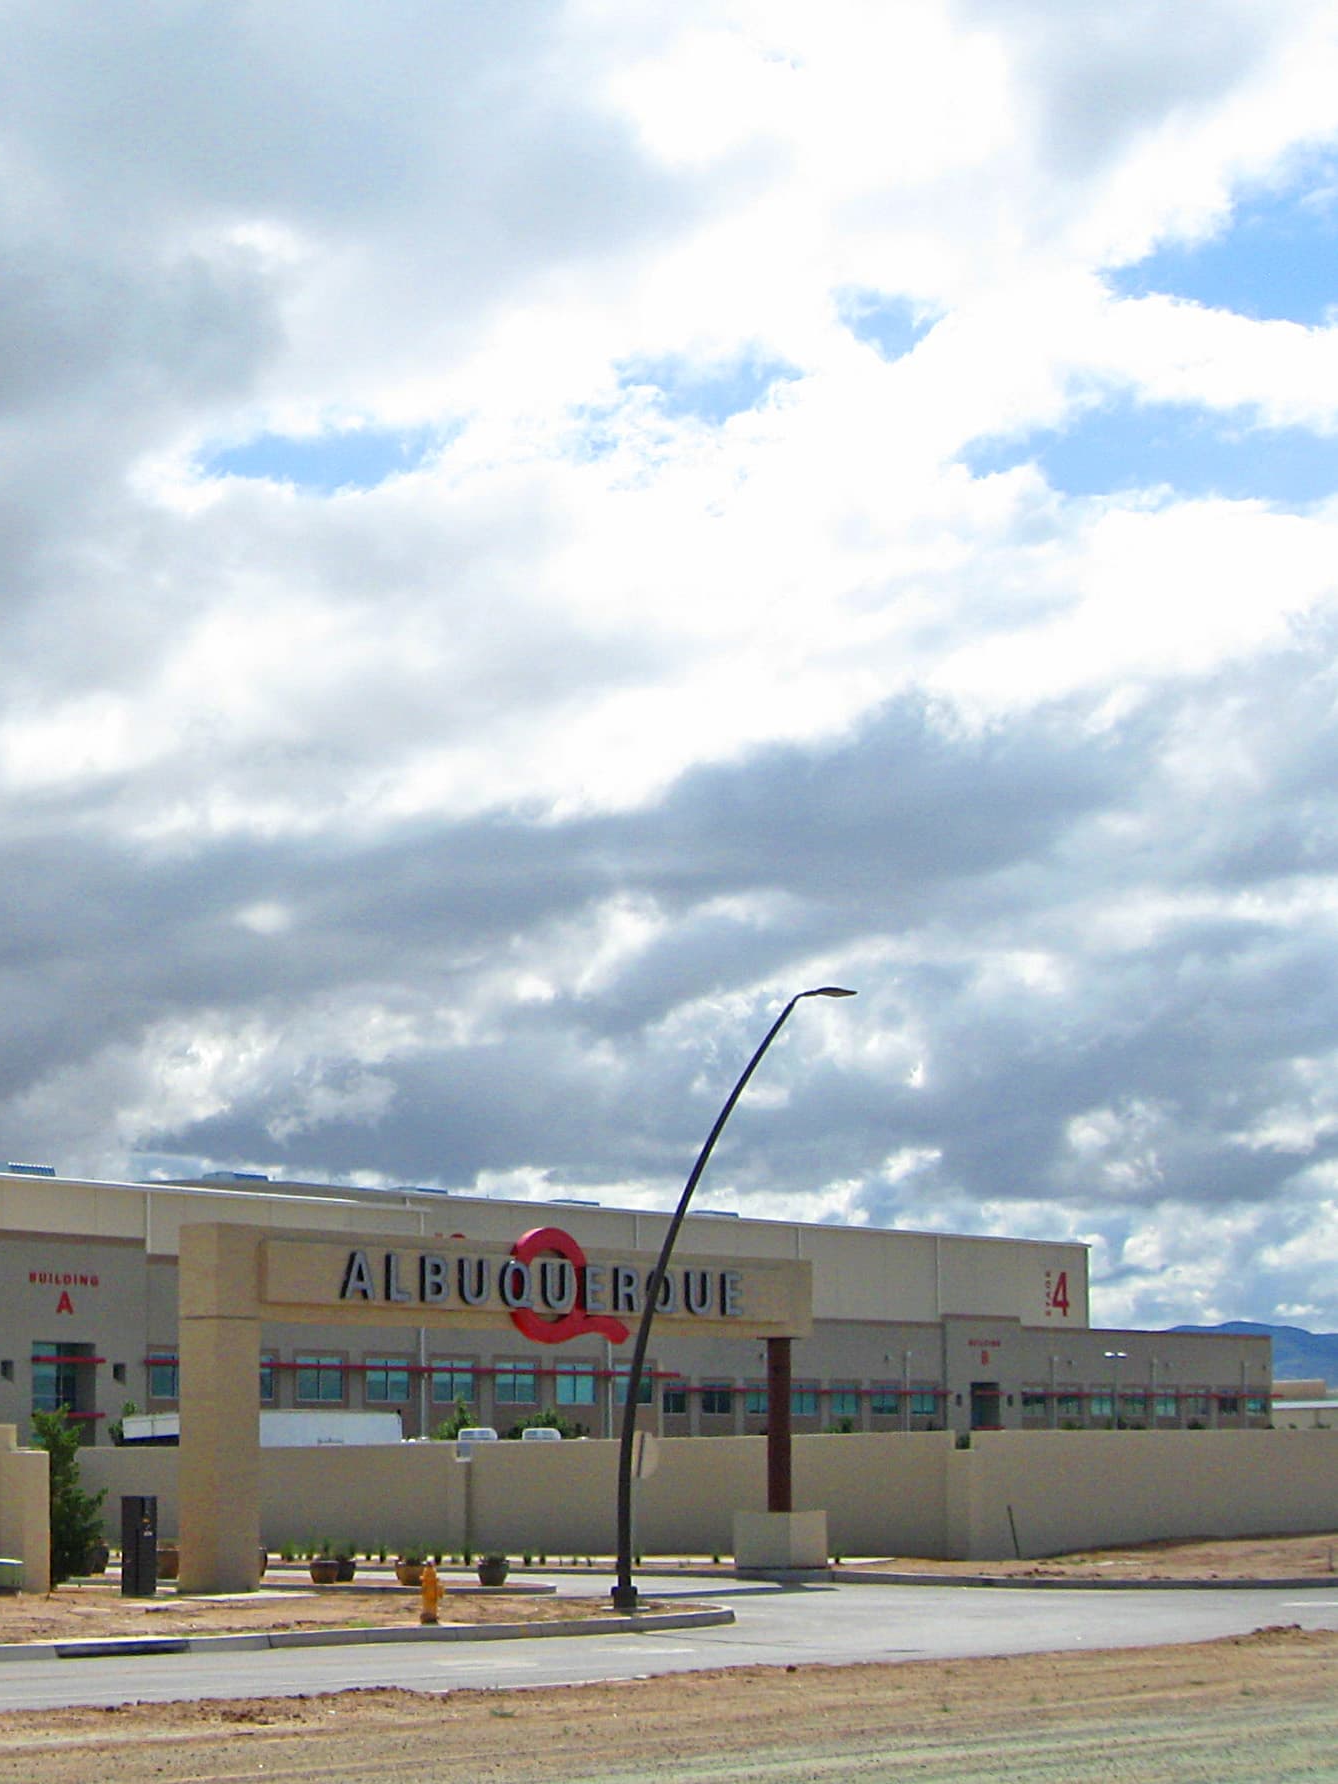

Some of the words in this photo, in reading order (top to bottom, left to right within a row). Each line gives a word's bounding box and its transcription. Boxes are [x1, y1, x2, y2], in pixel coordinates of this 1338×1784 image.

[28, 1271, 99, 1287] BUILDING
[340, 1250, 744, 1316] ALBUQUERQUE
[1052, 1271, 1070, 1317] 4
[55, 1290, 74, 1315] A
